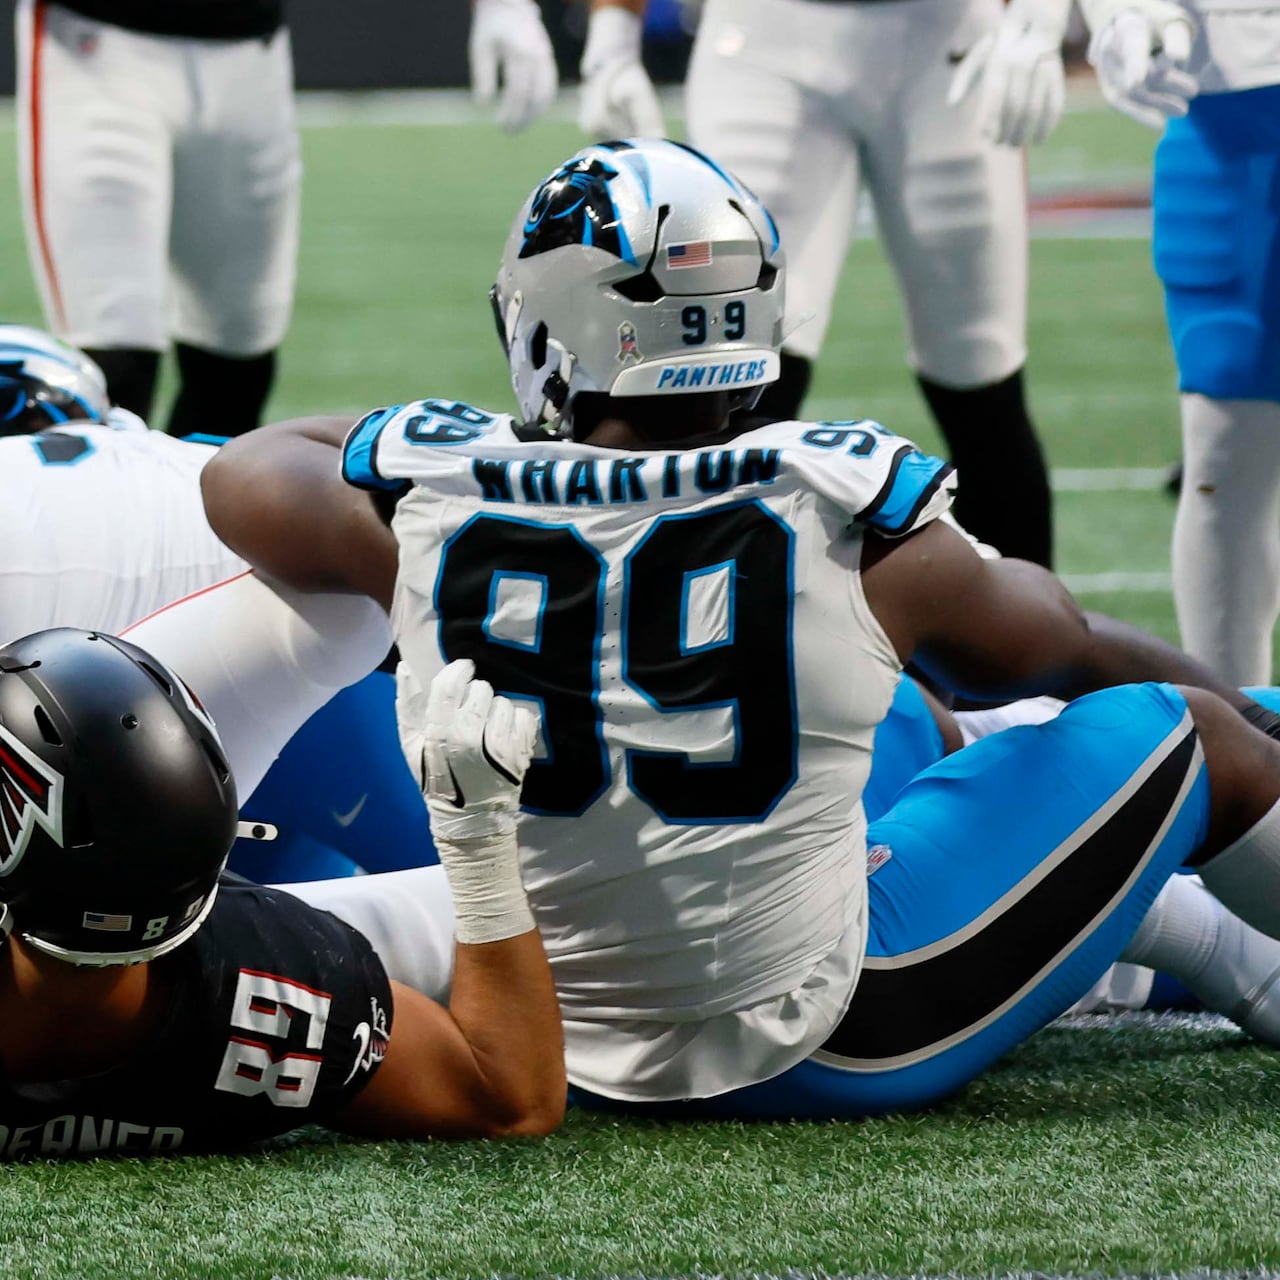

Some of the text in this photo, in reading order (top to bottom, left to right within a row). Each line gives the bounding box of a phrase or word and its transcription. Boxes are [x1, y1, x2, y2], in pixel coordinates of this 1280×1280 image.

[681, 300, 746, 345] 99
[657, 359, 768, 388] PANTHERS
[801, 418, 897, 459] 9
[435, 499, 798, 824] 99
[215, 968, 333, 1108] 89
